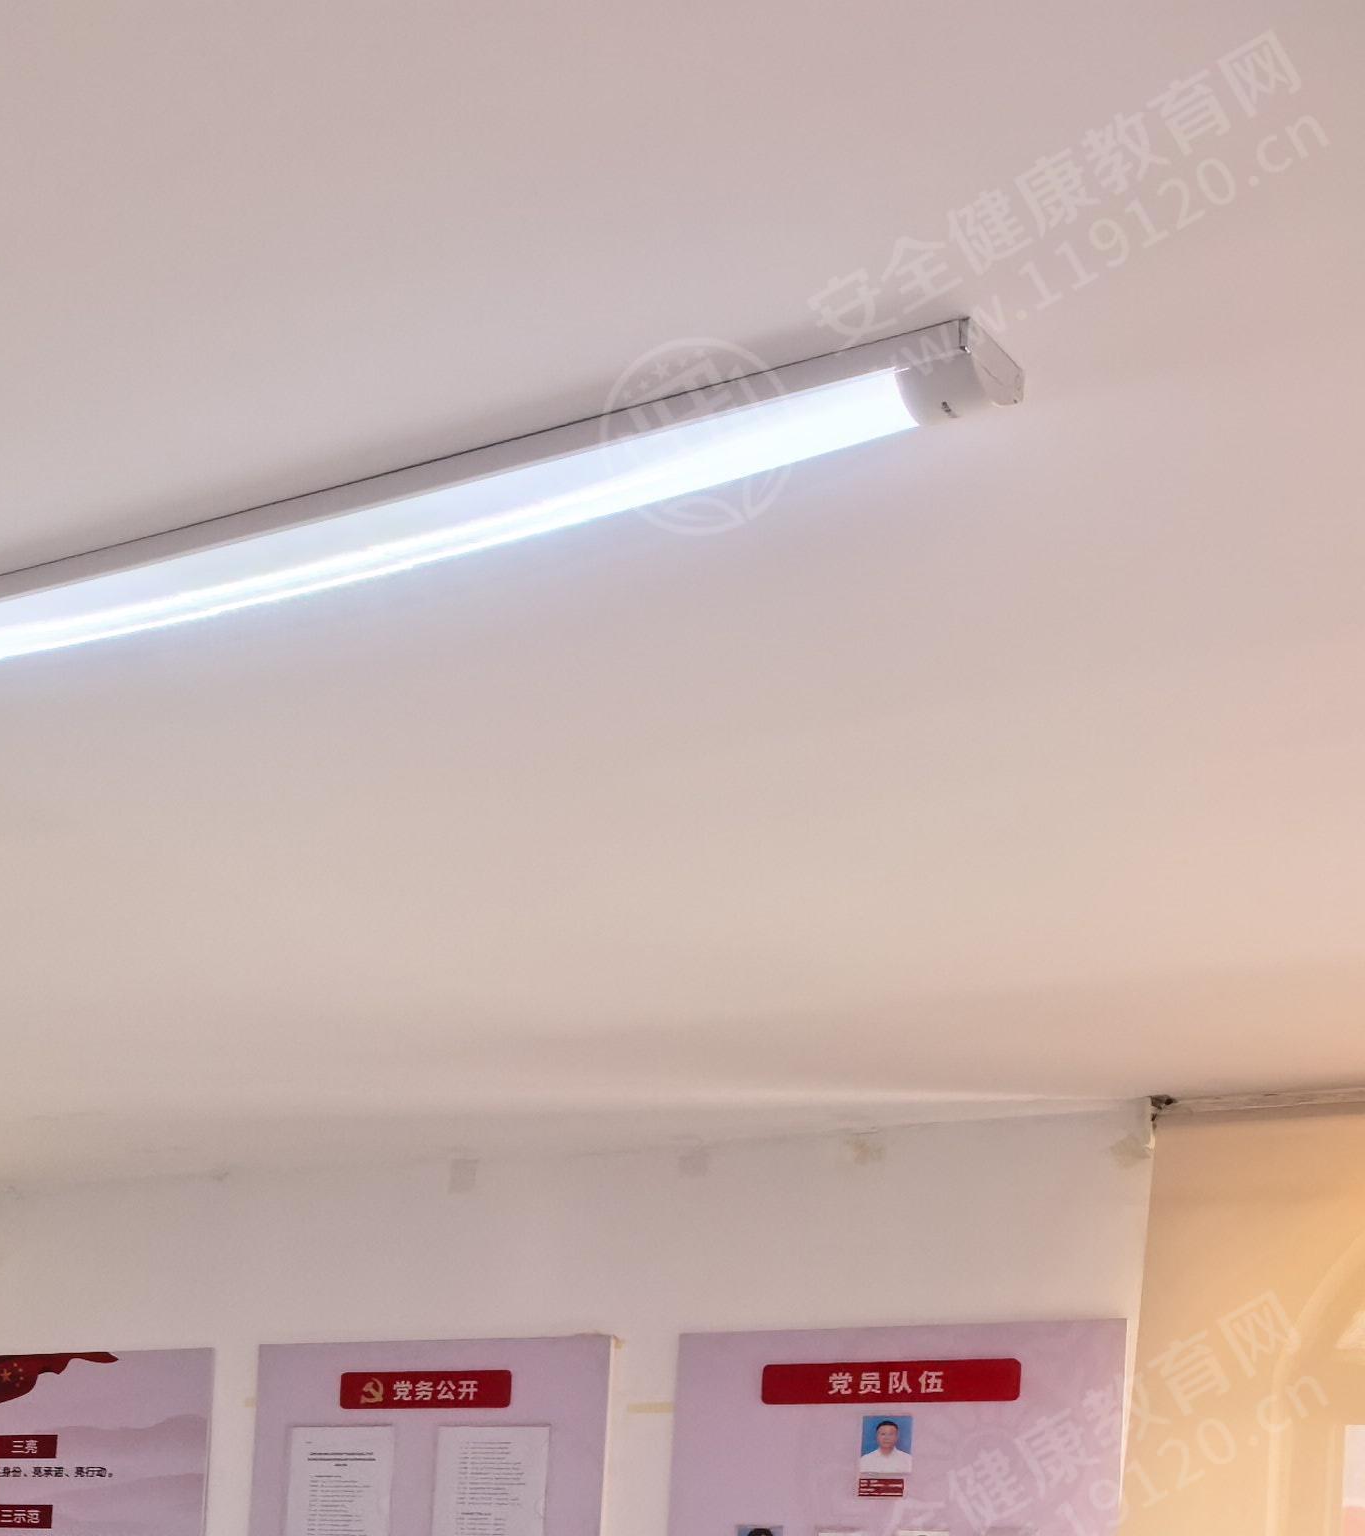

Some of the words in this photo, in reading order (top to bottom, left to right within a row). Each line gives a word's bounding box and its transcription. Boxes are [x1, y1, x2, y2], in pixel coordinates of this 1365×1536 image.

[393, 1380, 478, 1401] 党务公开
[828, 1370, 944, 1395] 党员队伍
[11, 1439, 37, 1454] 三亮
[0, 1509, 40, 1524] 三示范
